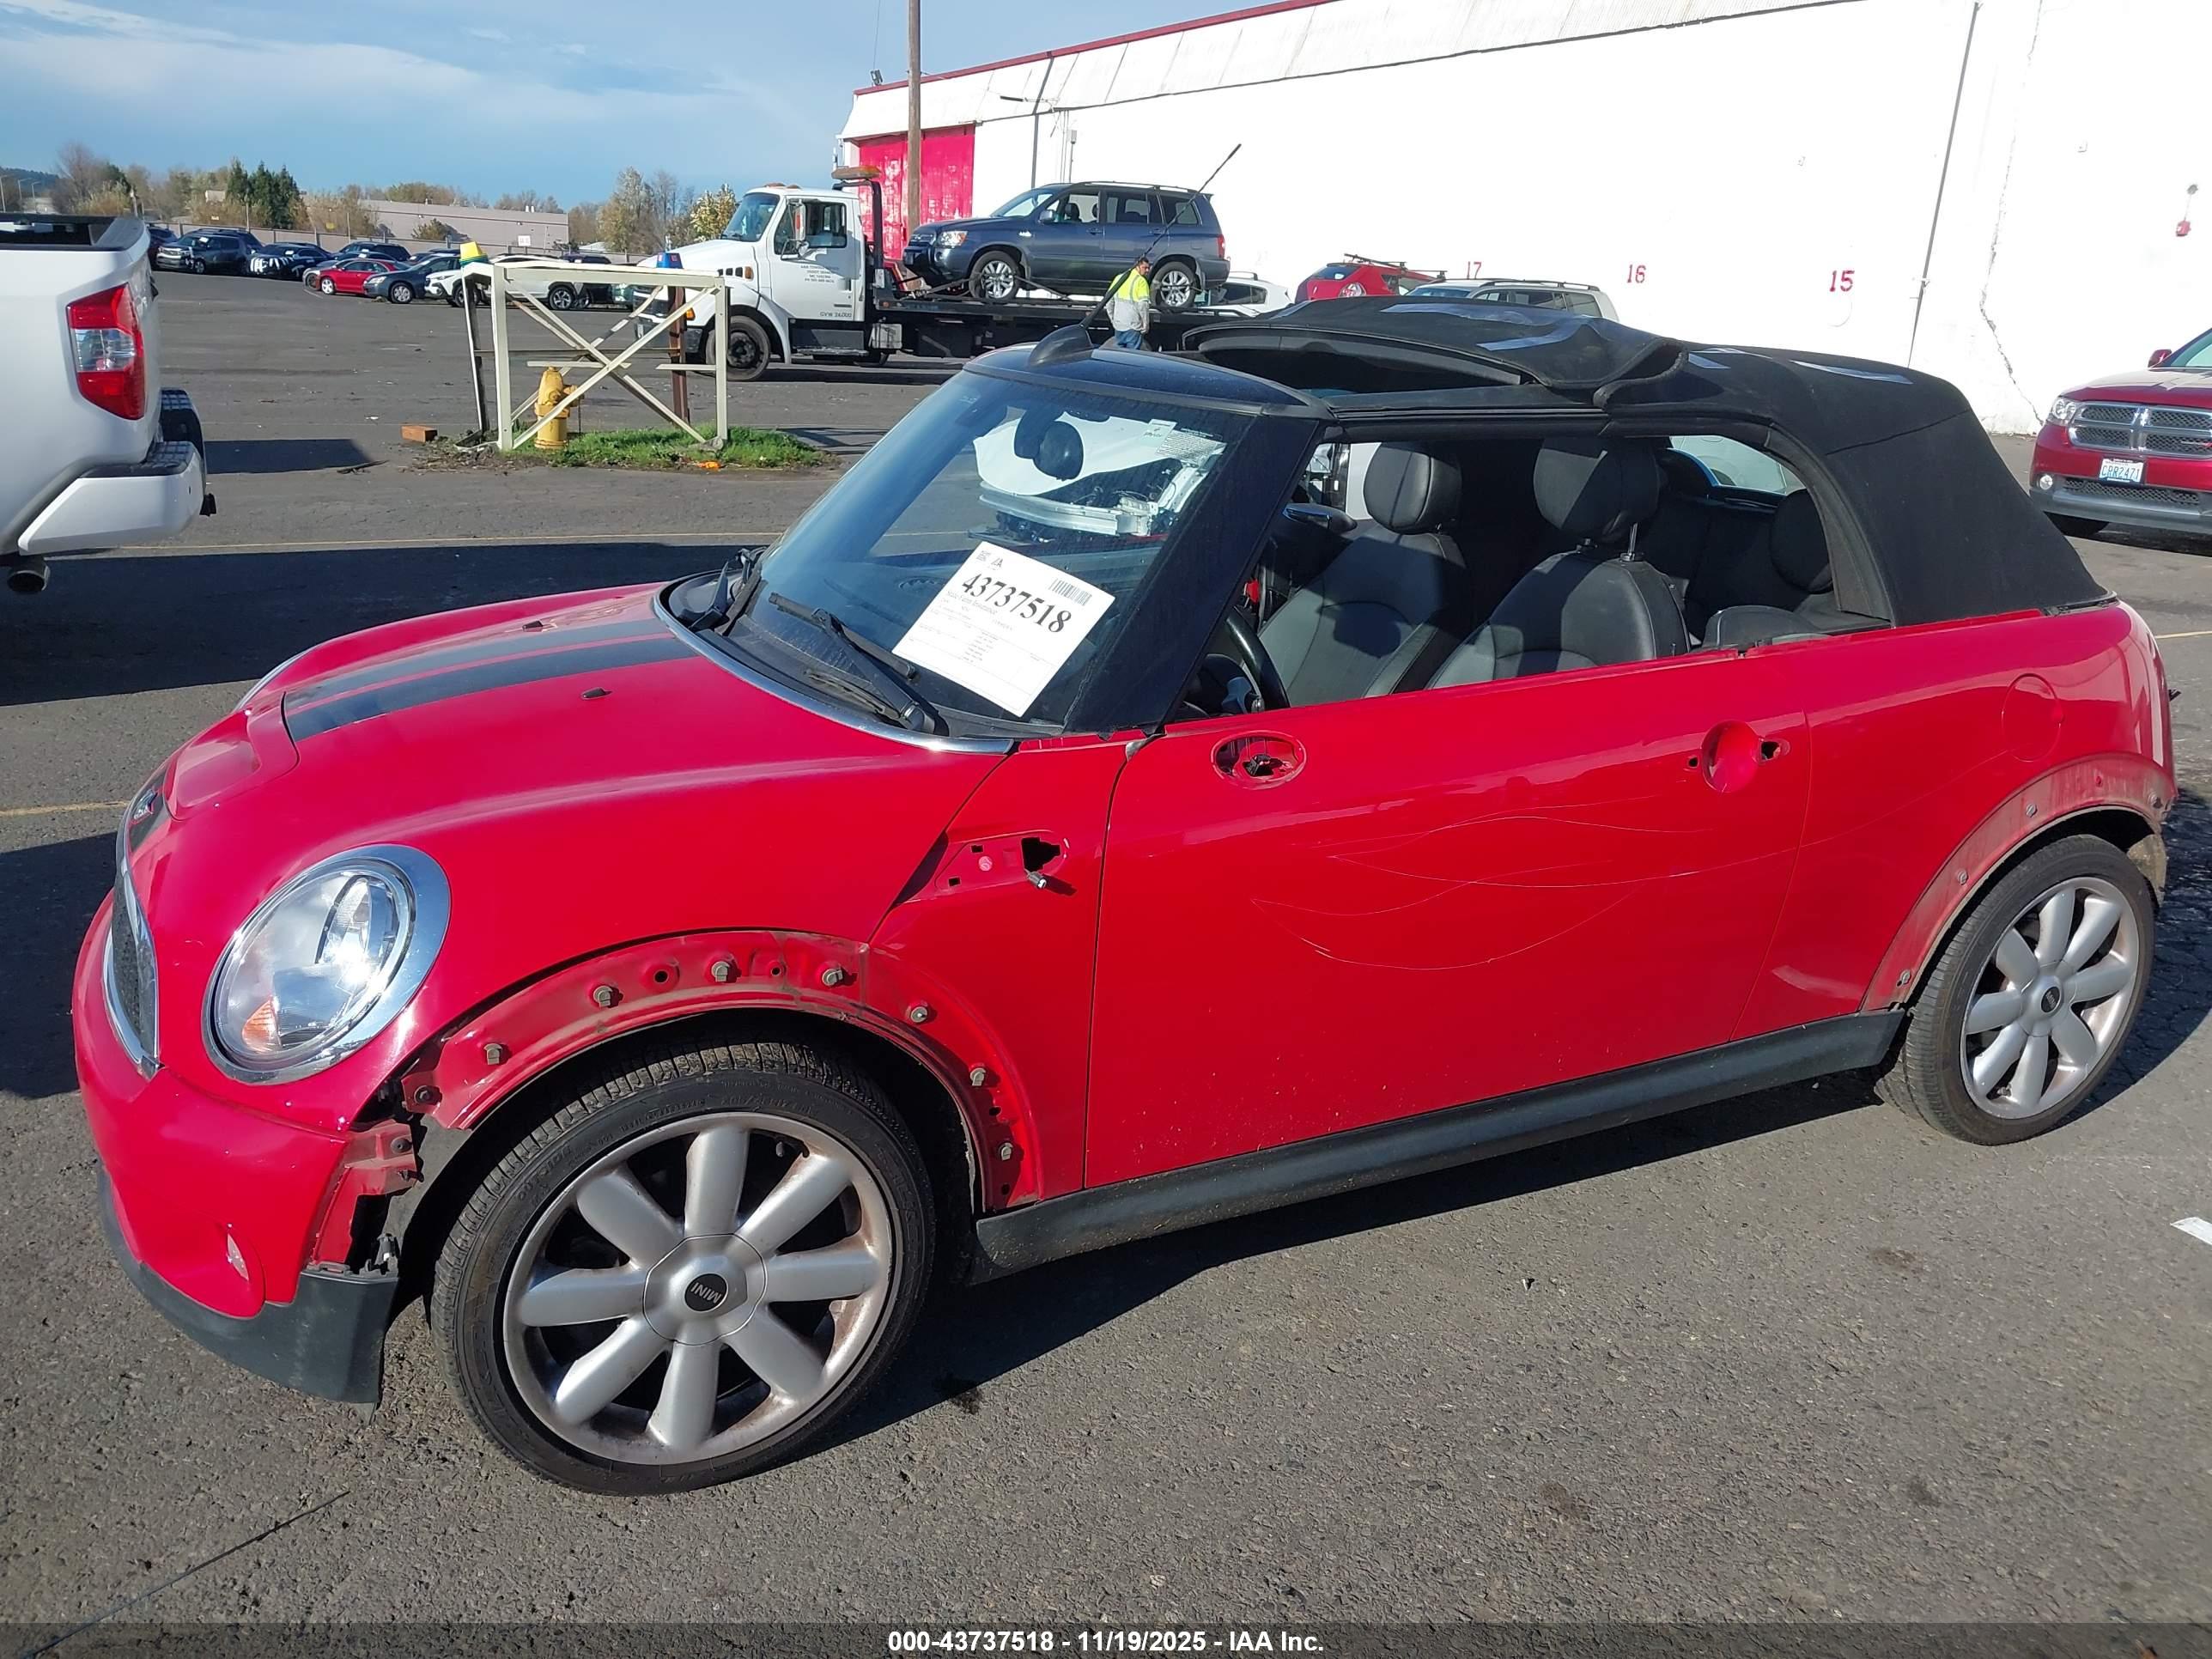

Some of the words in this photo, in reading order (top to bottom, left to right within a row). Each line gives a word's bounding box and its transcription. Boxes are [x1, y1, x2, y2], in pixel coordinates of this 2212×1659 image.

[1467, 261, 1482, 279] 17
[1627, 264, 1646, 283] 16
[1829, 270, 1855, 292] 15
[962, 574, 1072, 632] 43737518
[690, 1282, 721, 1304] MINI
